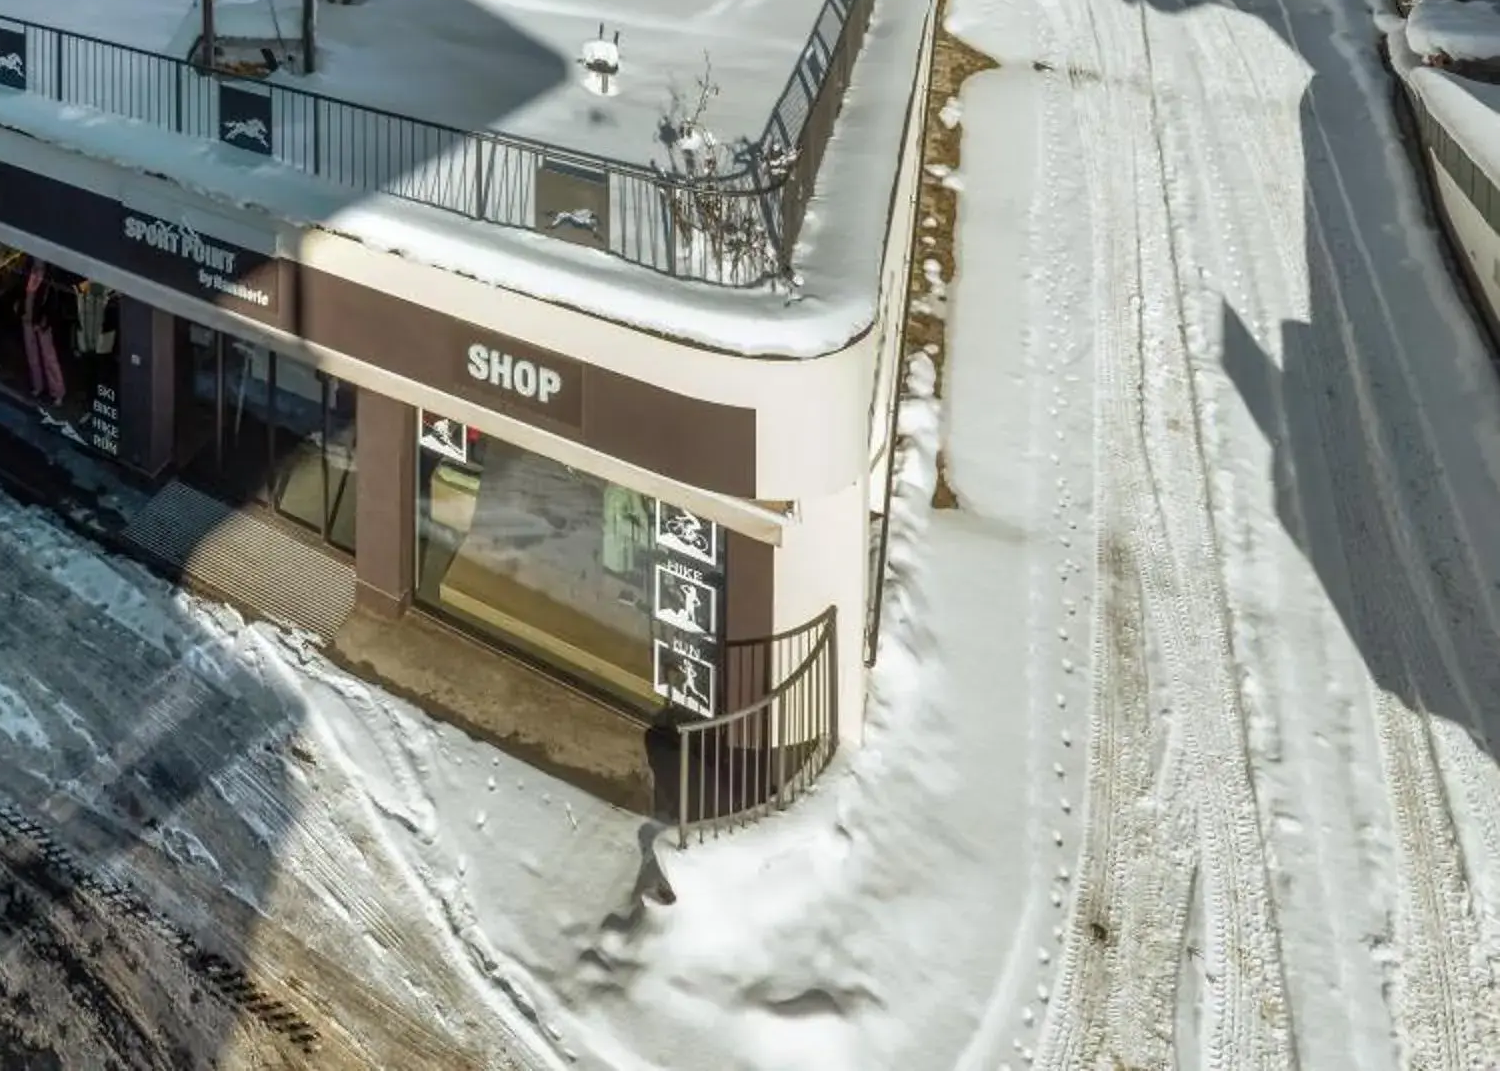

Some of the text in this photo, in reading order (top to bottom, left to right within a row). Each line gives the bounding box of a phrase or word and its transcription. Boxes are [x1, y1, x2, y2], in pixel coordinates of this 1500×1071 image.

[124, 216, 235, 273] SPORT POINT
[467, 343, 561, 403] SHOP
[667, 559, 703, 581] HIKE
